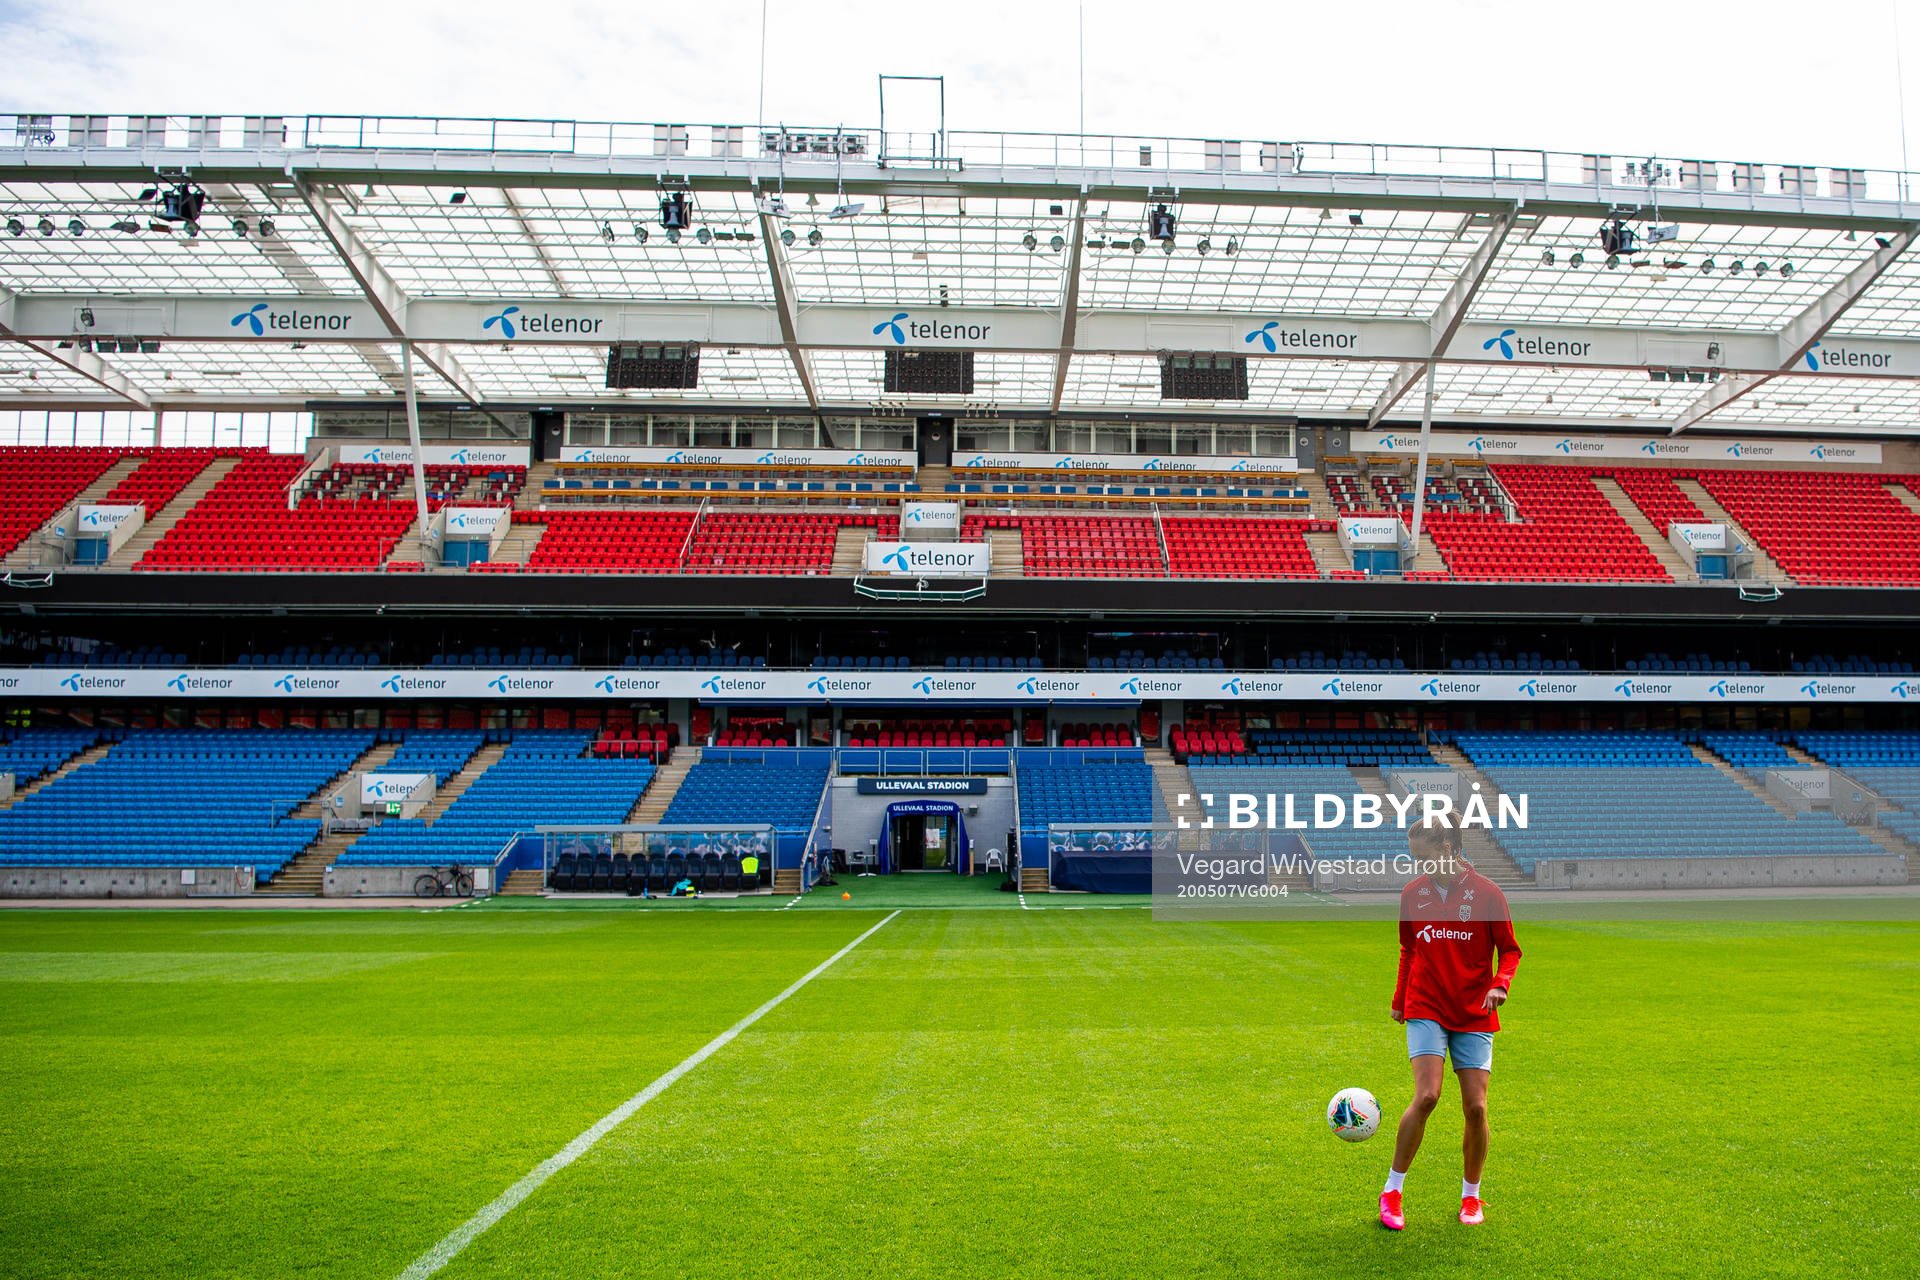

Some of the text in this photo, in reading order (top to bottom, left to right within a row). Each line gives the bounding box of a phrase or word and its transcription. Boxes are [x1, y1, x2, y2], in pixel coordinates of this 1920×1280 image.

[269, 310, 352, 330] telenor
[520, 313, 603, 333] telenor
[910, 320, 991, 340] telenor
[1280, 329, 1357, 349] telenor
[1517, 336, 1592, 356] telenor
[1822, 348, 1891, 368] telenor
[1394, 437, 1420, 447] telen
[1482, 438, 1517, 449] telenor
[1570, 442, 1604, 452] telenor
[1656, 444, 1689, 454] telenor
[1740, 446, 1773, 455] telenor
[1823, 447, 1856, 457] telenor
[467, 450, 506, 462] telenor
[592, 452, 631, 463] telenor
[683, 453, 722, 464] telenor
[773, 454, 812, 465] telenor
[864, 456, 902, 466] telenor
[983, 458, 1021, 468] telenor
[1071, 459, 1109, 470] telenor
[1159, 461, 1197, 471] telenor
[1246, 463, 1283, 472] telenor
[466, 515, 498, 525] teleno
[922, 510, 956, 520] telenor
[1360, 525, 1393, 535] telenor
[1690, 531, 1721, 541] telenor
[910, 550, 975, 566] telenor
[80, 677, 125, 688] telenor
[187, 678, 232, 688] telenor
[294, 678, 339, 689] telenor
[401, 678, 446, 689] telenor
[508, 678, 554, 689] telenor
[614, 678, 660, 689] telenor
[721, 679, 766, 690] telenor
[826, 679, 871, 690] telenor
[931, 679, 976, 691] telenor
[1036, 680, 1080, 691] telenor
[1138, 680, 1182, 691] telenor
[1239, 680, 1283, 691] telenor
[1340, 681, 1383, 692] telenor
[1439, 682, 1480, 693] telenor
[1535, 682, 1577, 693] telenor
[1631, 683, 1672, 694] telenor
[1725, 683, 1765, 694] telenor
[1817, 683, 1856, 694] telenor
[385, 784, 417, 794] telen
[876, 781, 969, 790] ULLEVAAL STADION
[1416, 781, 1454, 791] telenor
[1431, 927, 1473, 941] telenor
